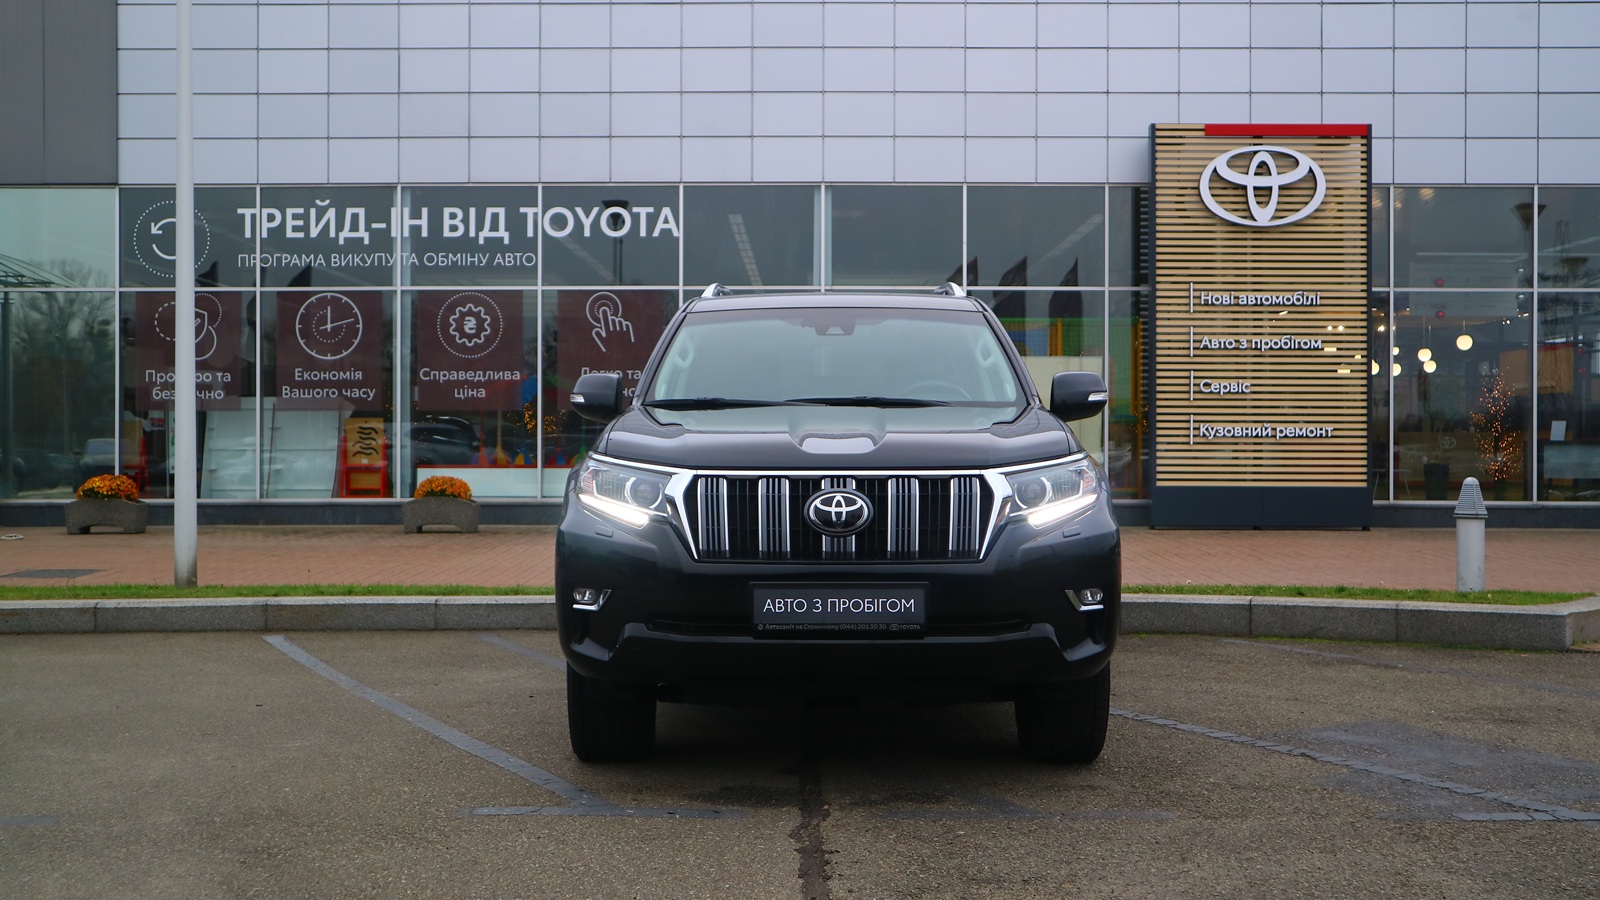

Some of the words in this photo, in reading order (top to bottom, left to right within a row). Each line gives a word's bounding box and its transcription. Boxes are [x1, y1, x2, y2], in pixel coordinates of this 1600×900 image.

[237, 199, 429, 245] ТРЕЙД-ІН
[443, 206, 510, 245] ВІД
[519, 206, 680, 238] TOYOTA
[238, 253, 326, 267] ПРОГРАМА
[332, 253, 396, 267] ВИКУПУ
[400, 253, 419, 266] ТА
[424, 252, 489, 266] ОБМІНУ
[493, 252, 536, 266] АВТО
[1201, 292, 1234, 306] Нові
[1239, 291, 1321, 306] автомобілі
[1200, 336, 1236, 349] Авто
[1239, 338, 1248, 349] з
[1251, 336, 1322, 352] пробігом
[216, 372, 231, 382] та
[294, 368, 363, 381] Економія
[419, 368, 520, 383] Справедлива
[152, 387, 224, 400] безчно
[282, 386, 338, 398] Вашого
[342, 388, 375, 400] часу
[454, 386, 485, 399] ціна
[1200, 380, 1250, 395] Сервіс
[1200, 423, 1272, 439] Кузовний
[1276, 426, 1333, 440] ремонт
[763, 598, 807, 613] АВТО
[812, 598, 822, 613] З
[827, 598, 915, 613] ПРОБІГОМ
